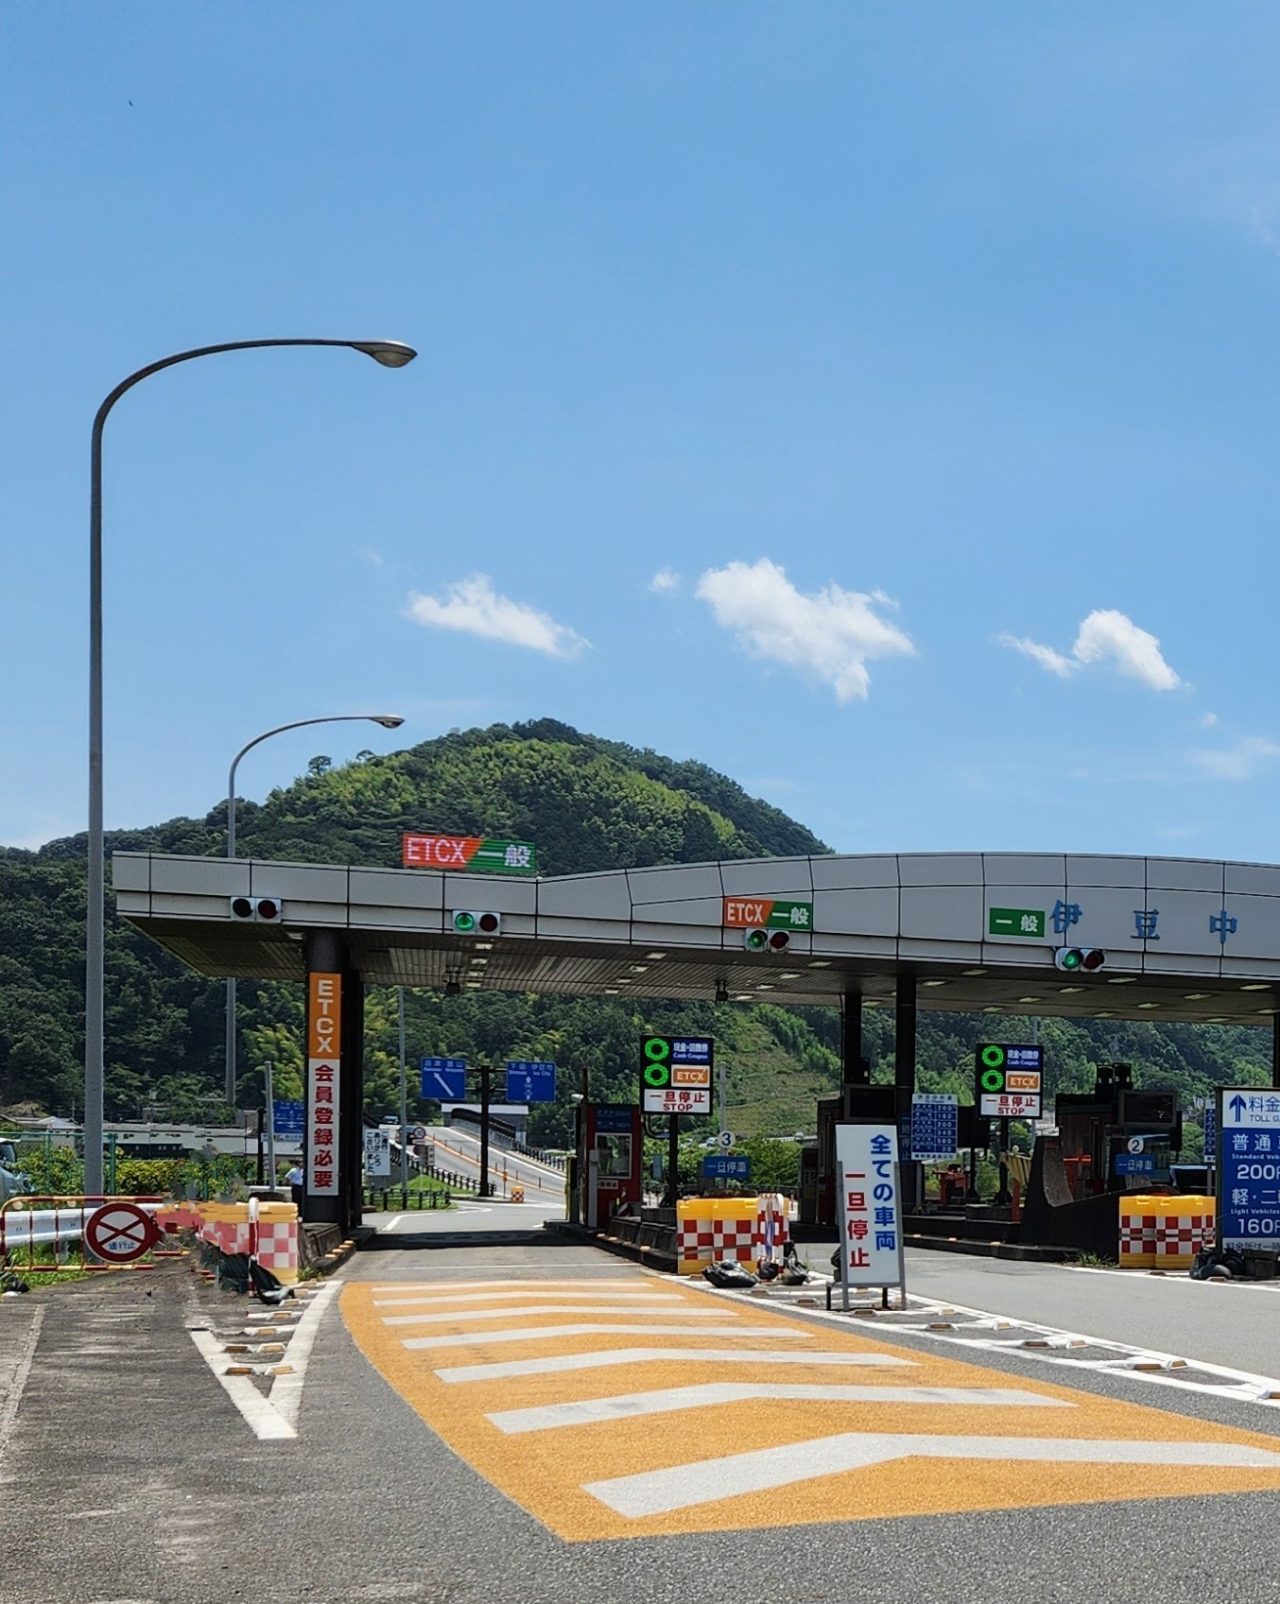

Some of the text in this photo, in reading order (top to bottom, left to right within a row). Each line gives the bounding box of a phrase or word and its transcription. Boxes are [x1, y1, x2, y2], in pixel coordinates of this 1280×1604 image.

[407, 837, 532, 867] ETCX 一般
[727, 903, 810, 925] ETCX 一般
[995, 915, 1038, 932] 一般
[315, 979, 334, 1053] ETCX
[676, 1070, 705, 1082] ETCX
[1010, 1076, 1036, 1087] ETCX
[649, 1091, 706, 1103] 一旦停止
[986, 1095, 1036, 1107] 一旦停止
[663, 1103, 693, 1111] STOP
[998, 1107, 1025, 1115] STOP
[1250, 1114, 1271, 1123] TOLL
[313, 1064, 334, 1188] 会員登録必要
[721, 1132, 732, 1146] 3
[1131, 1139, 1140, 1152] 2
[706, 1160, 747, 1174] 一旦停車
[870, 1134, 896, 1251] 全ての車両
[845, 1173, 870, 1267] 一旦停止
